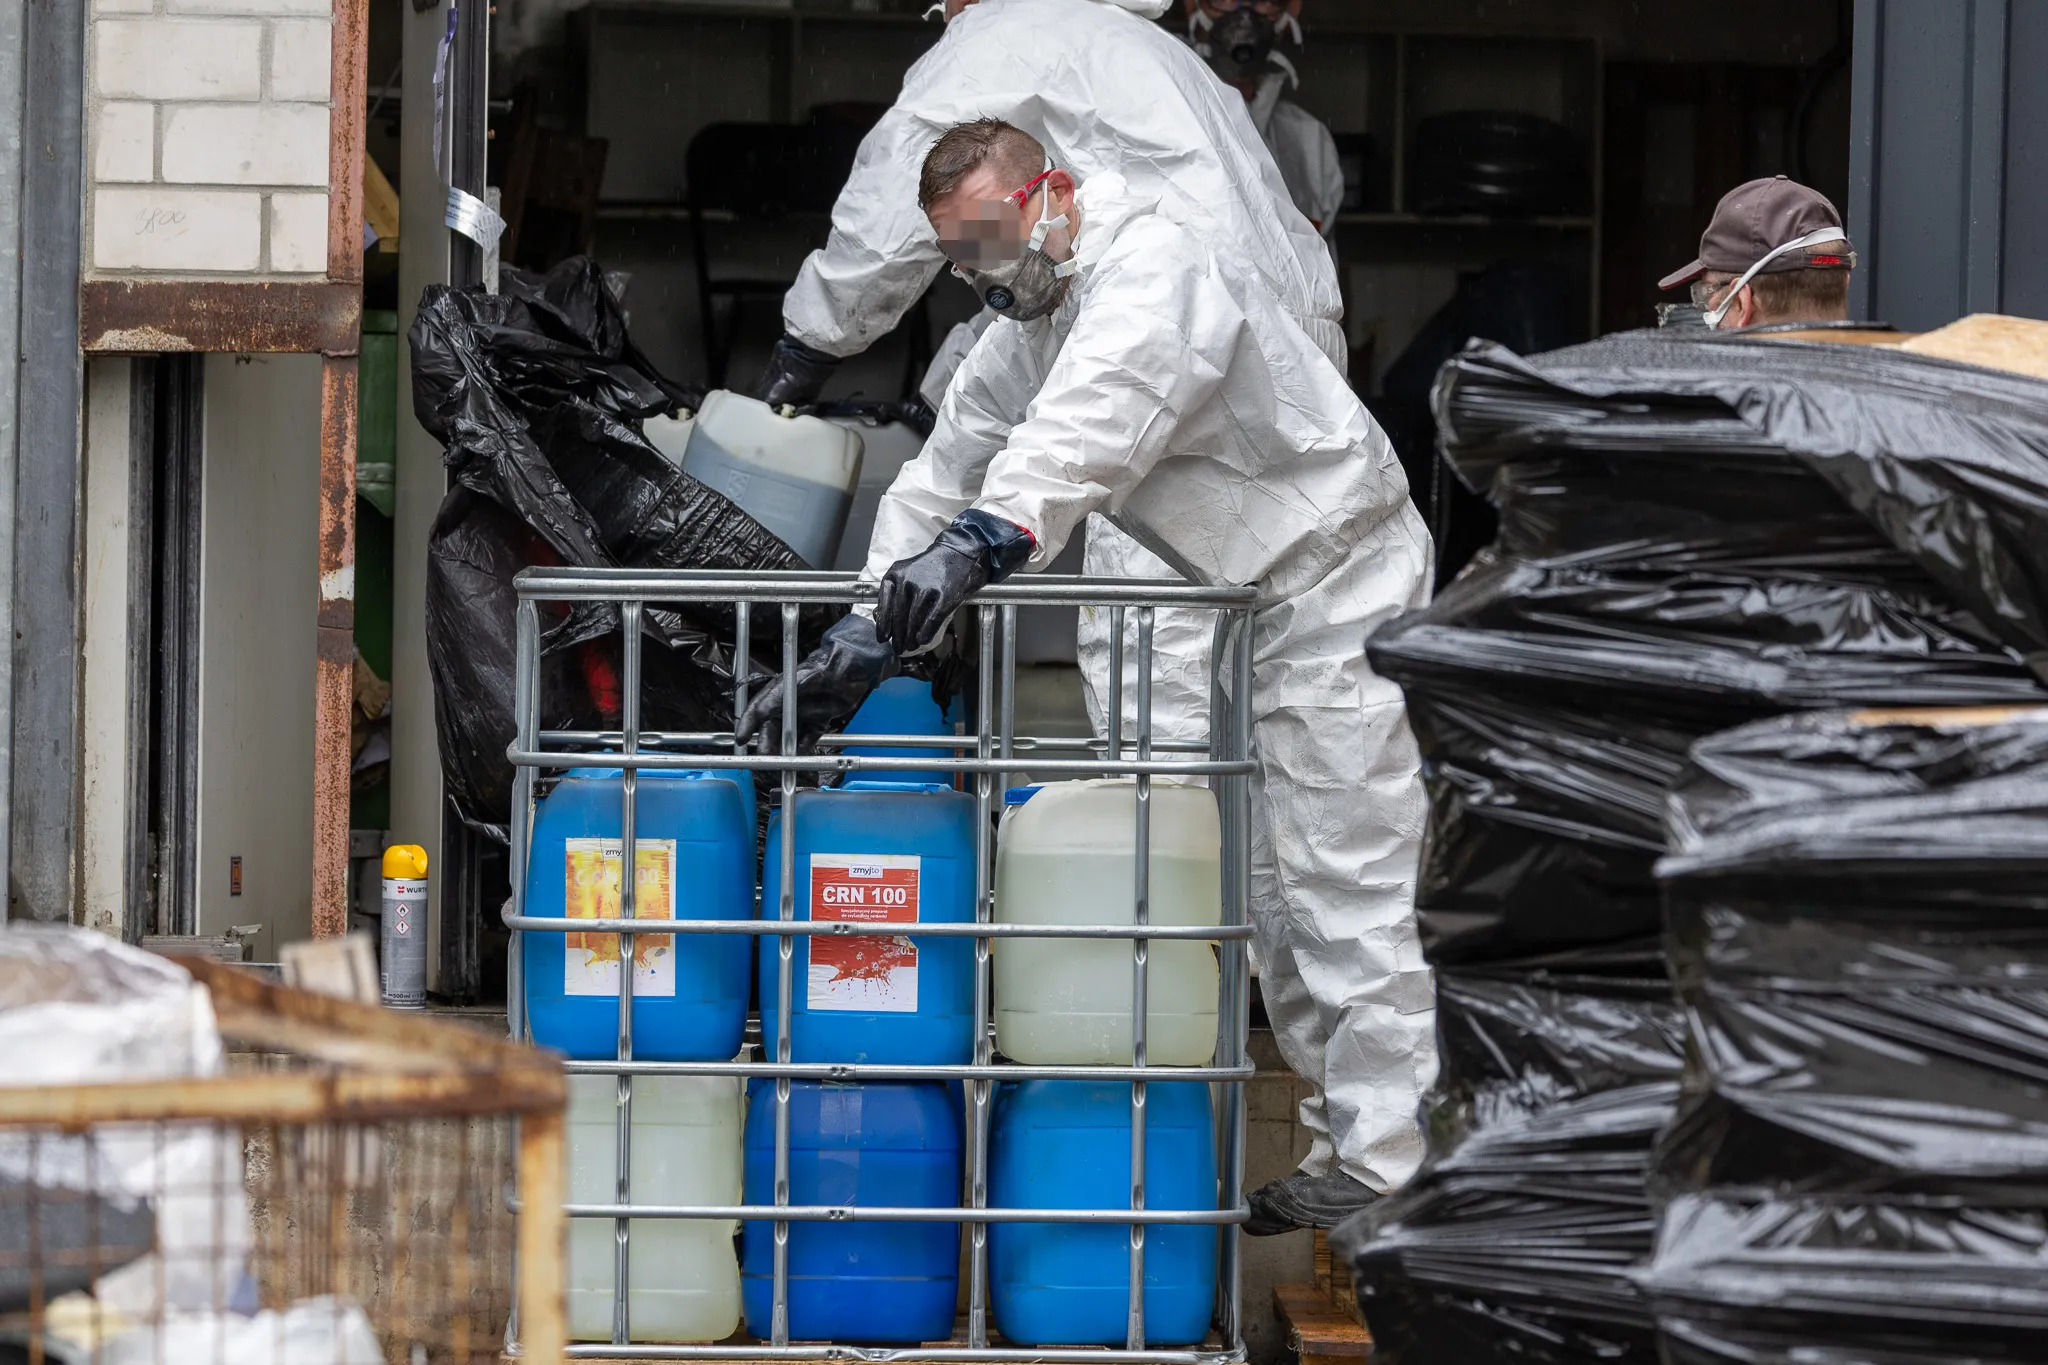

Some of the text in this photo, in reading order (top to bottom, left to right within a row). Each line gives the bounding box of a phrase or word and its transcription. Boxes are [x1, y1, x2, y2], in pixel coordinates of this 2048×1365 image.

[853, 867, 879, 875] zmyjto
[823, 886, 906, 904] CRN 100
